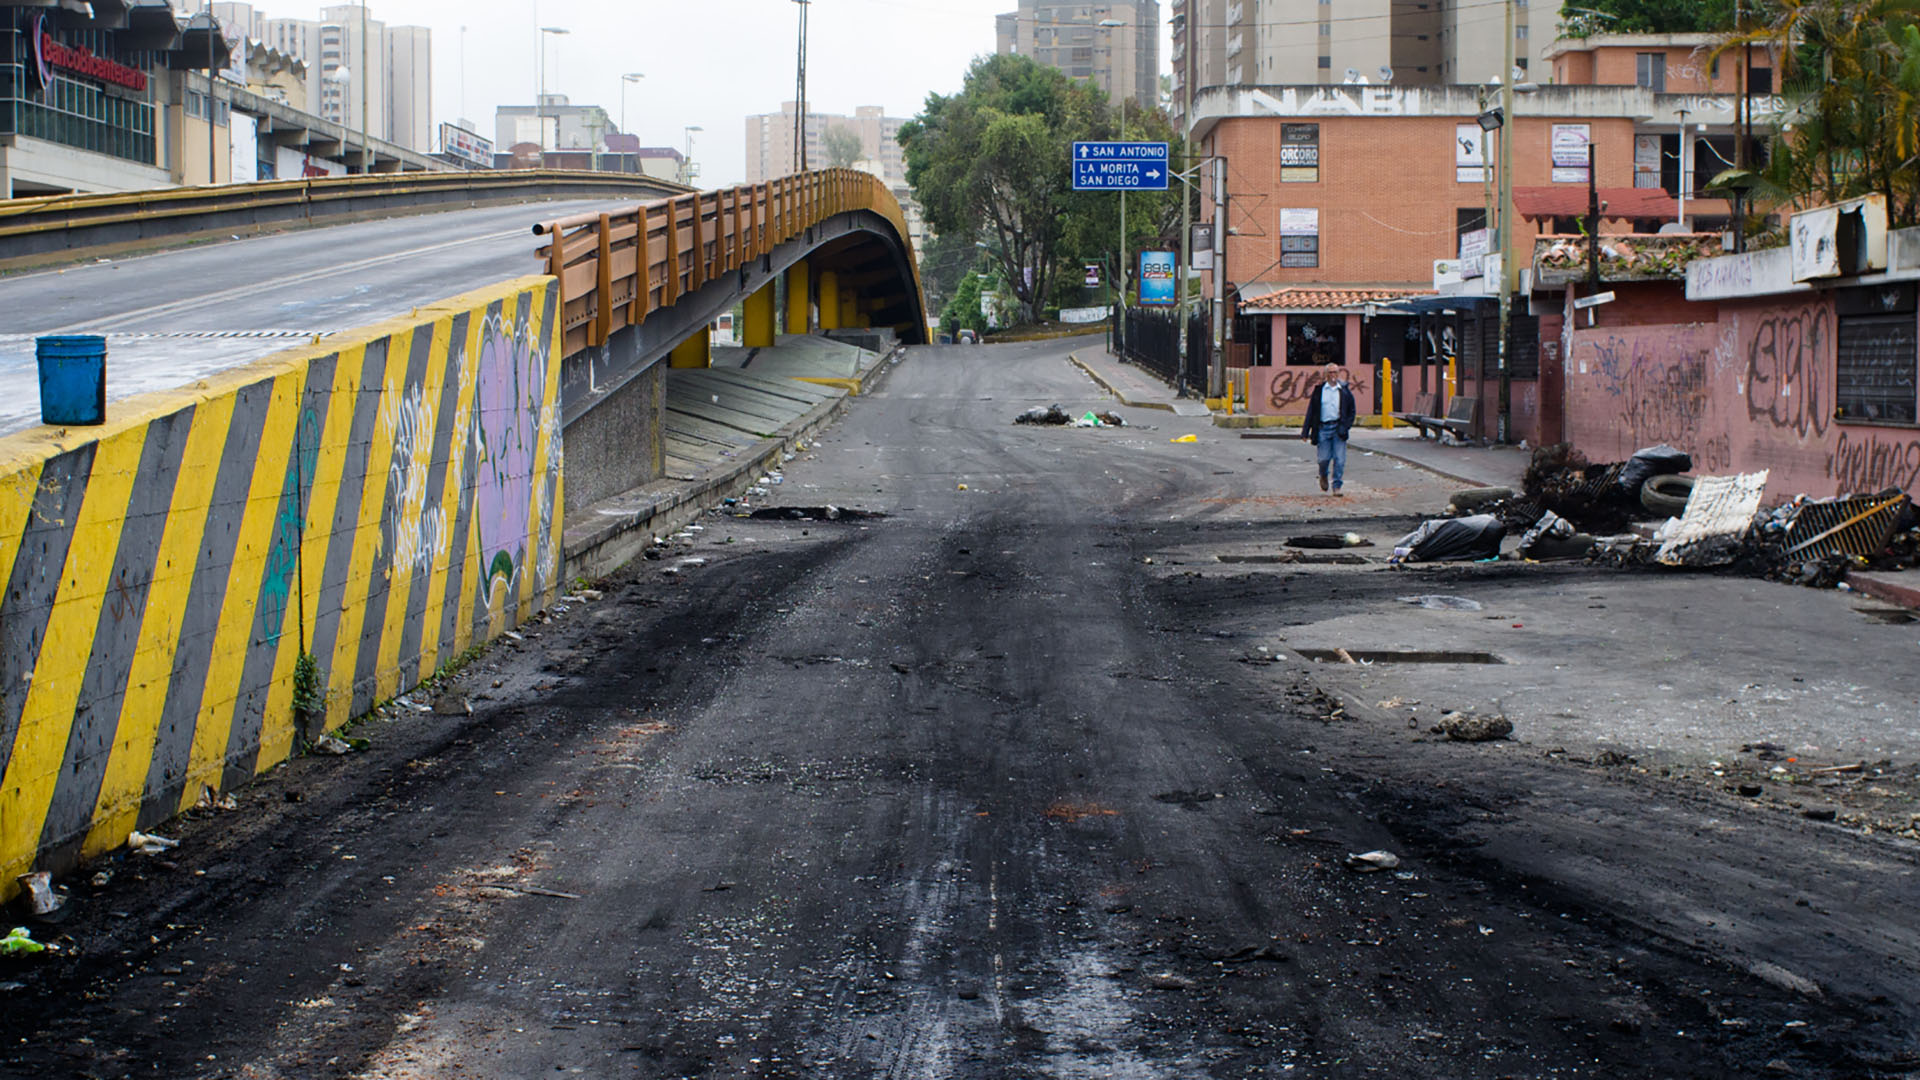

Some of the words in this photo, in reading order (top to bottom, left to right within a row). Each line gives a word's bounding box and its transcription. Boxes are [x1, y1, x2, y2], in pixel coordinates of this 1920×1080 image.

[1092, 146, 1114, 157] SAN
[1119, 146, 1165, 157] ANTONIO
[1080, 163, 1095, 174] LA
[1100, 163, 1139, 174] MORITA
[1080, 175, 1103, 185] SAN
[1107, 175, 1139, 185] DIEGO
